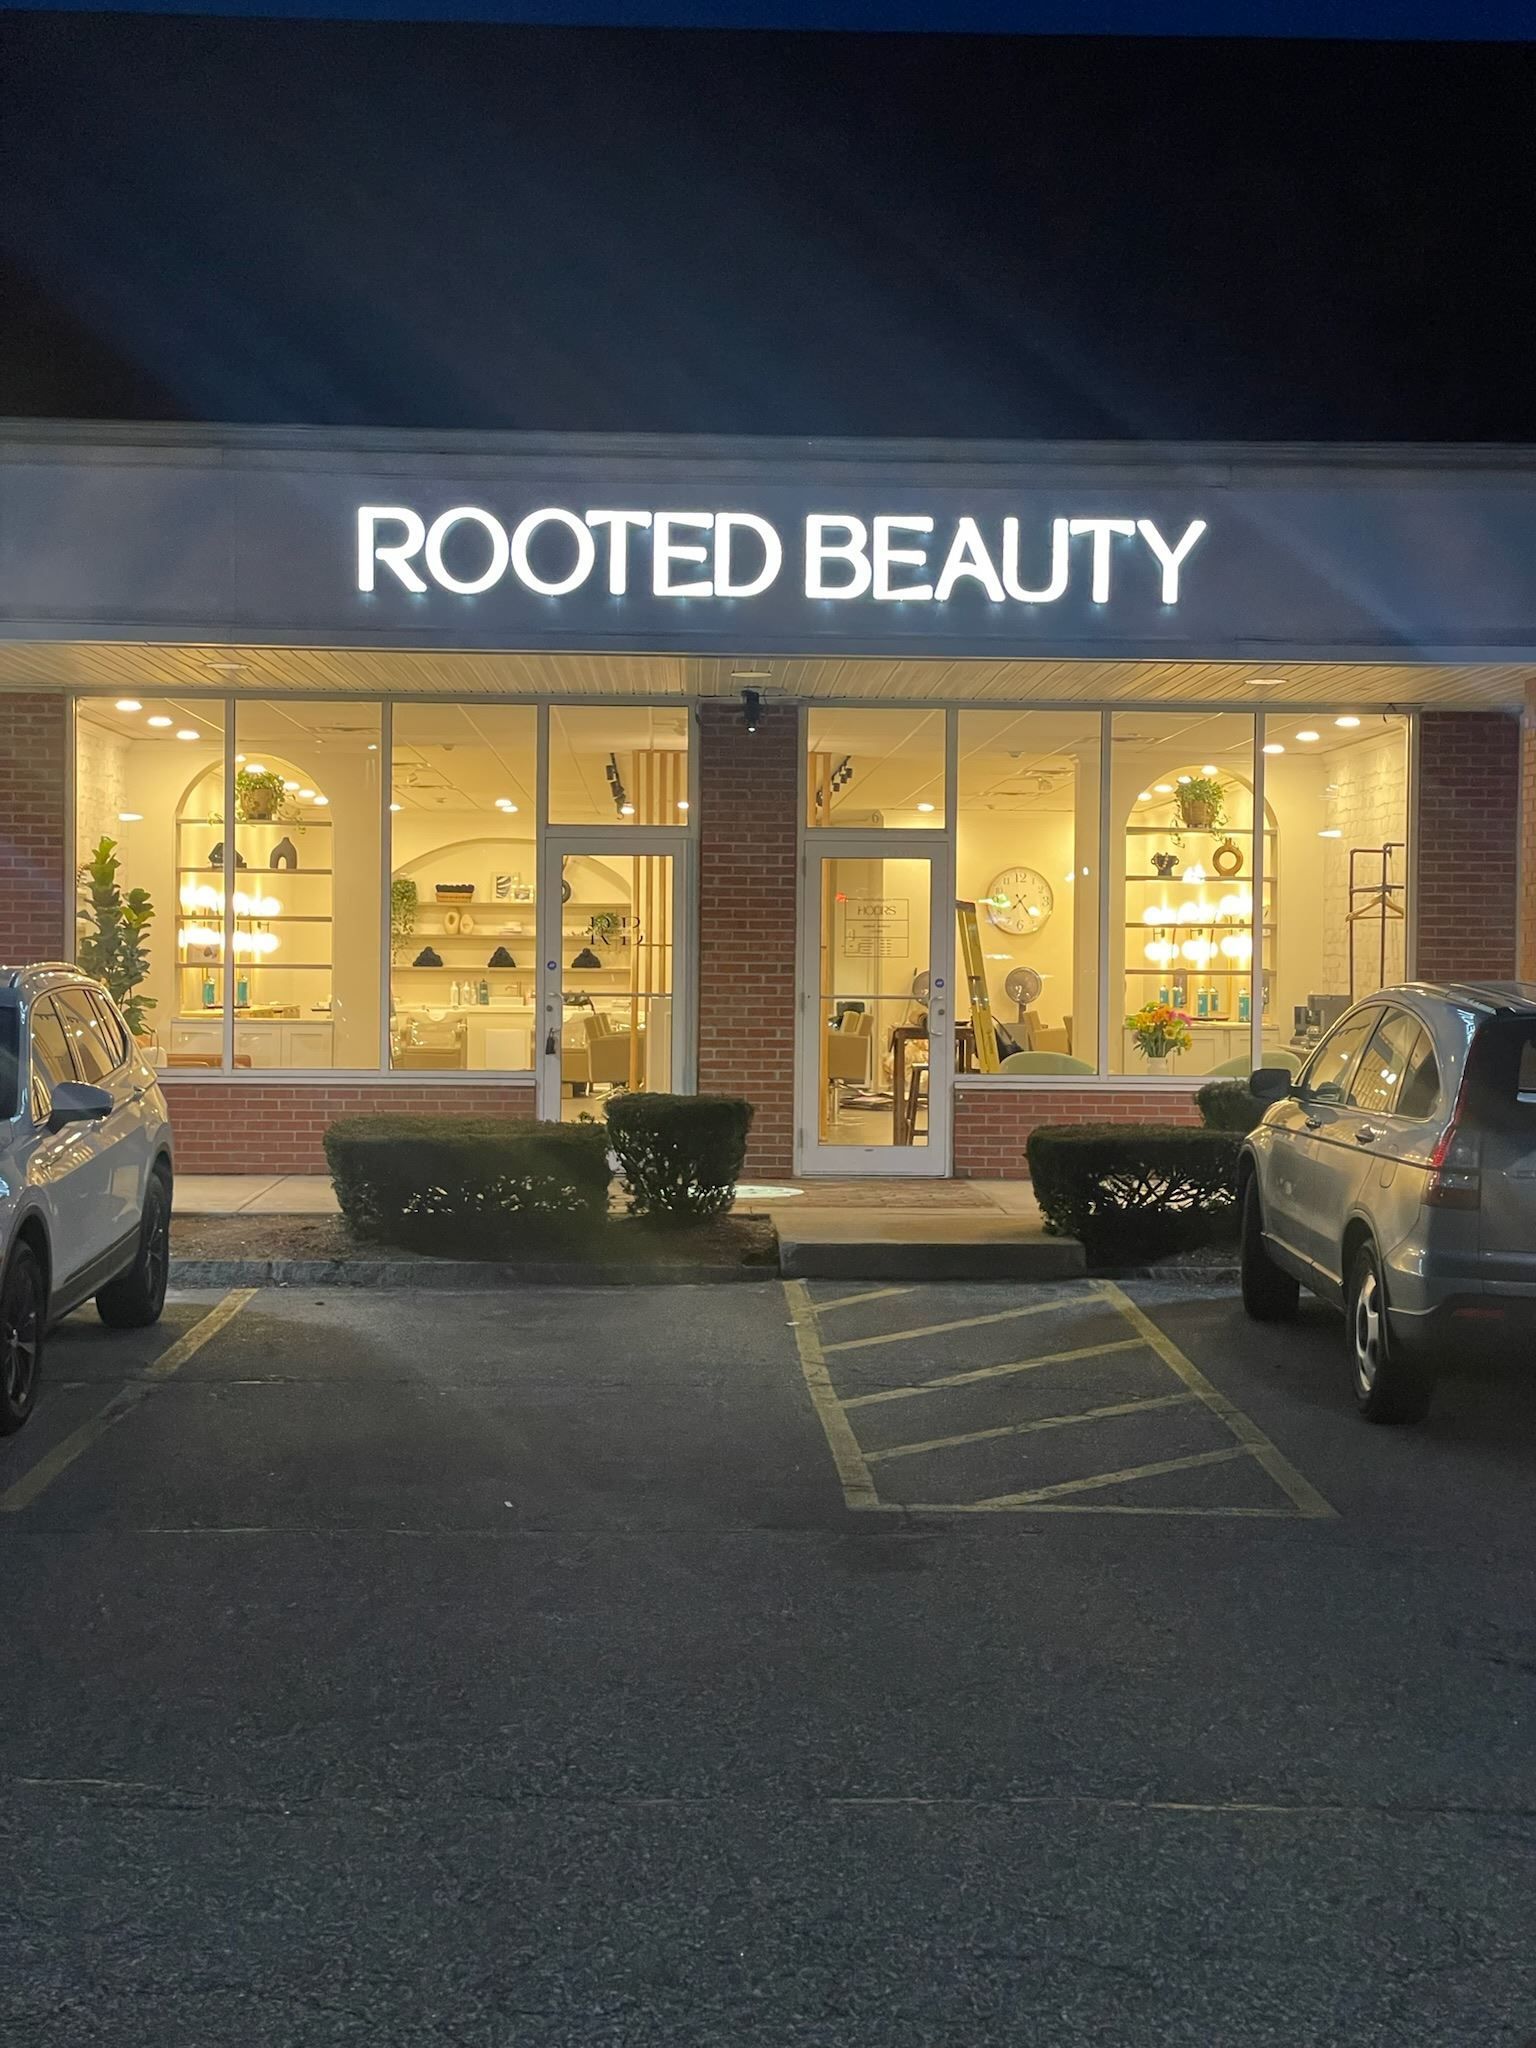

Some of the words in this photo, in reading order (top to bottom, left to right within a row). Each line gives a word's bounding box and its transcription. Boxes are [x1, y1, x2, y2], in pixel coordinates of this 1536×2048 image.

[358, 506, 783, 597] ROOTED
[805, 514, 1207, 604] BEAUTY
[1003, 877, 1010, 885] 11
[1015, 873, 1027, 883] 12
[1042, 896, 1050, 907] 3
[857, 905, 897, 916] HOURS
[1016, 919, 1025, 932] 6
